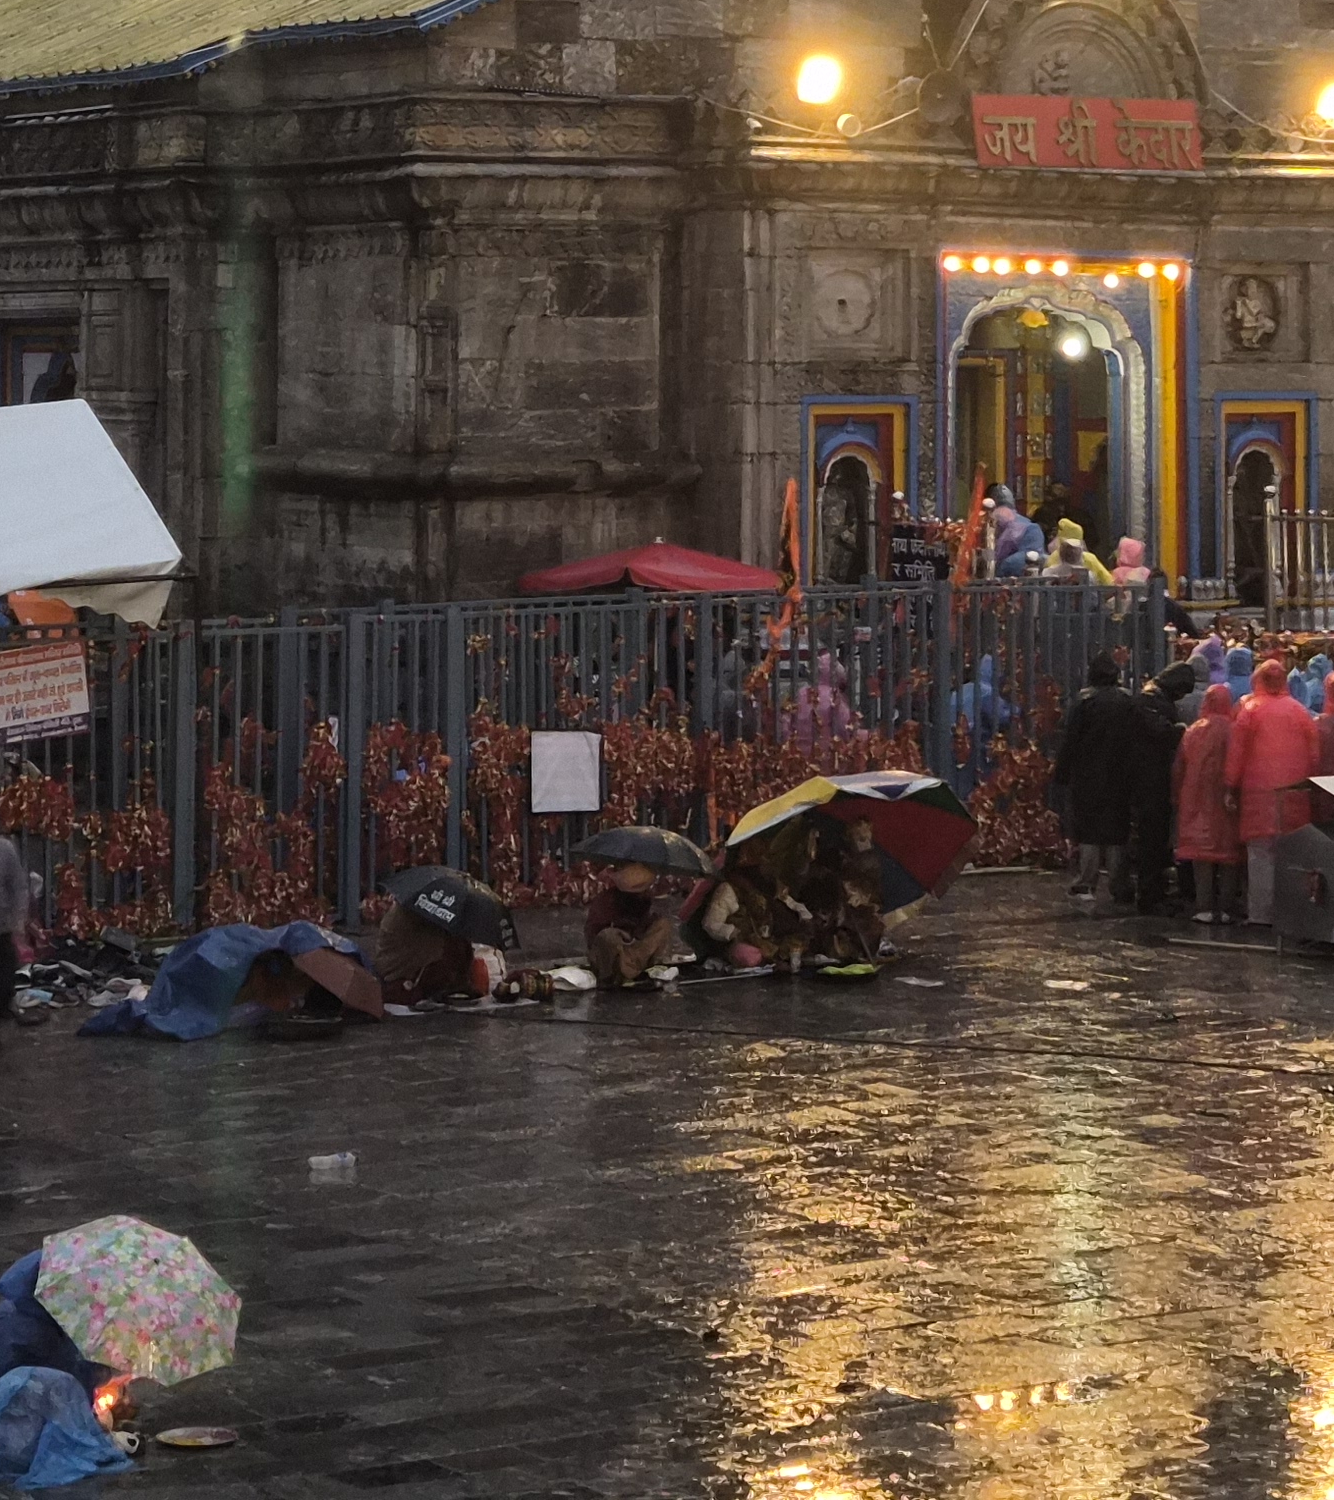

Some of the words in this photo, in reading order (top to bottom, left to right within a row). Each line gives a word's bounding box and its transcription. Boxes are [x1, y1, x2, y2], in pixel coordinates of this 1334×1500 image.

[982, 115, 1038, 163] जय
[1057, 99, 1097, 168] श्री
[1111, 100, 1198, 169] केदार
